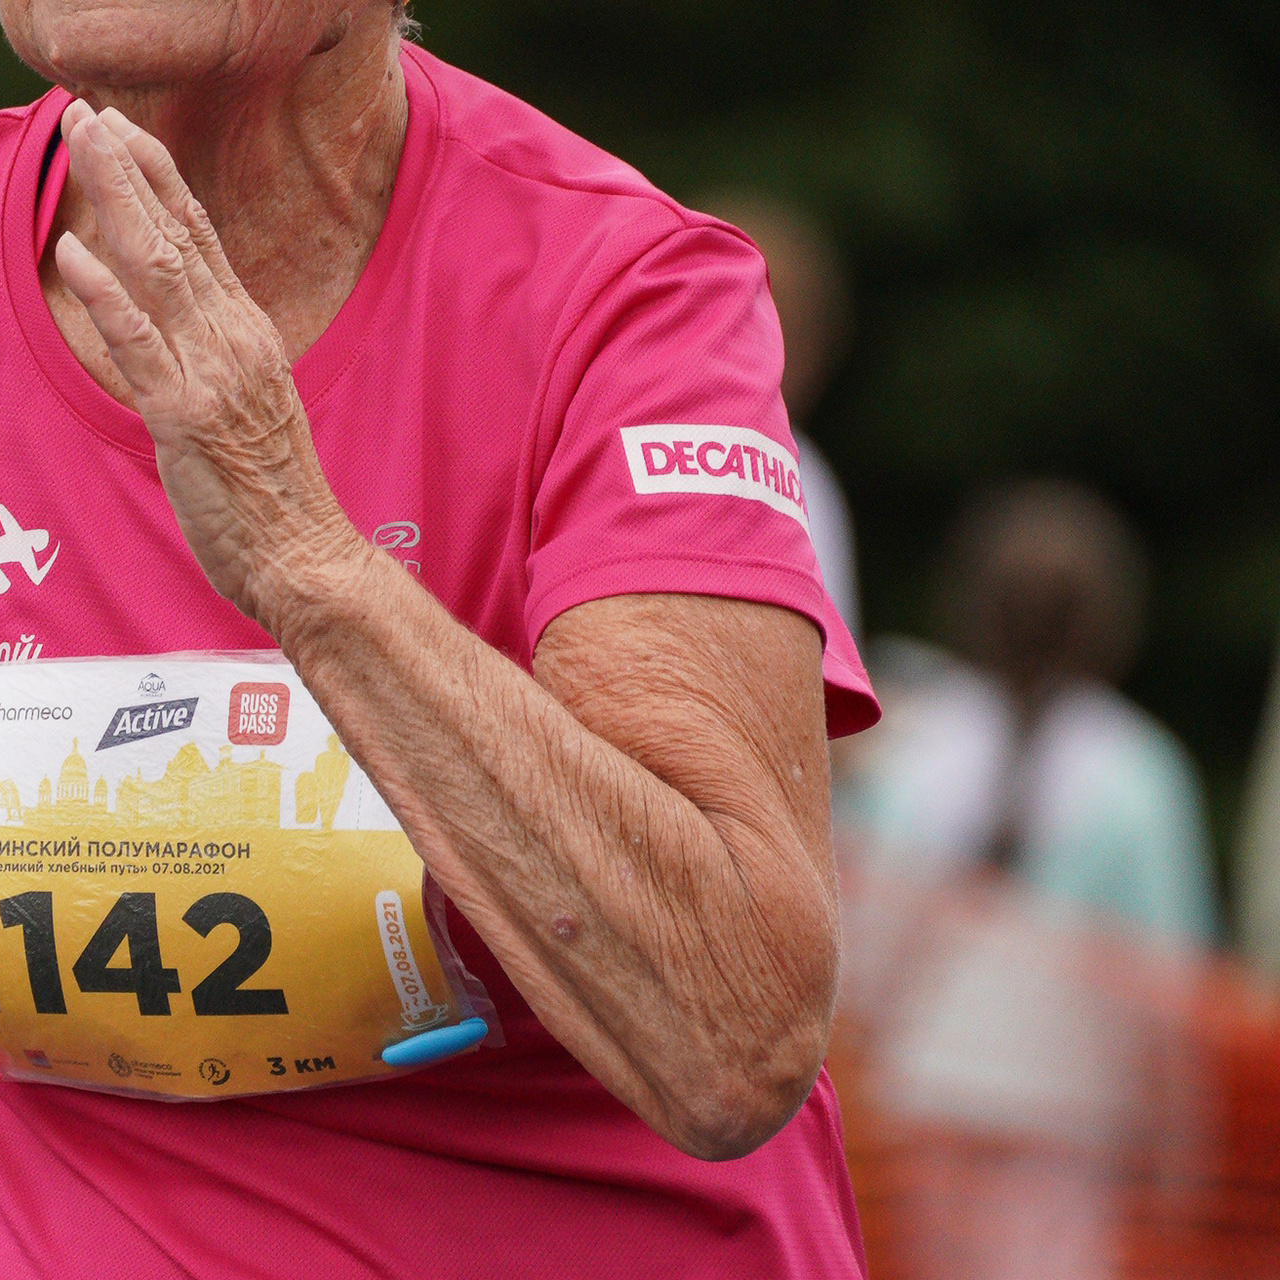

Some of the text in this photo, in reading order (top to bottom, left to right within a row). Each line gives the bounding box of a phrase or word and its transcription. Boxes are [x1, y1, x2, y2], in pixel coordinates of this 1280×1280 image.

[640, 440, 810, 517] DECATHLO
[137, 680, 166, 693] AQUA
[240, 693, 279, 714] RUSS
[238, 713, 277, 735] PASS
[87, 841, 250, 859] ПОЛУМАРАФОН
[47, 861, 107, 874] хлебный
[110, 864, 148, 876] путь»
[152, 863, 226, 875] 07.08.2021
[382, 902, 419, 995] 07.08.2021
[266, 1056, 287, 1076] 3
